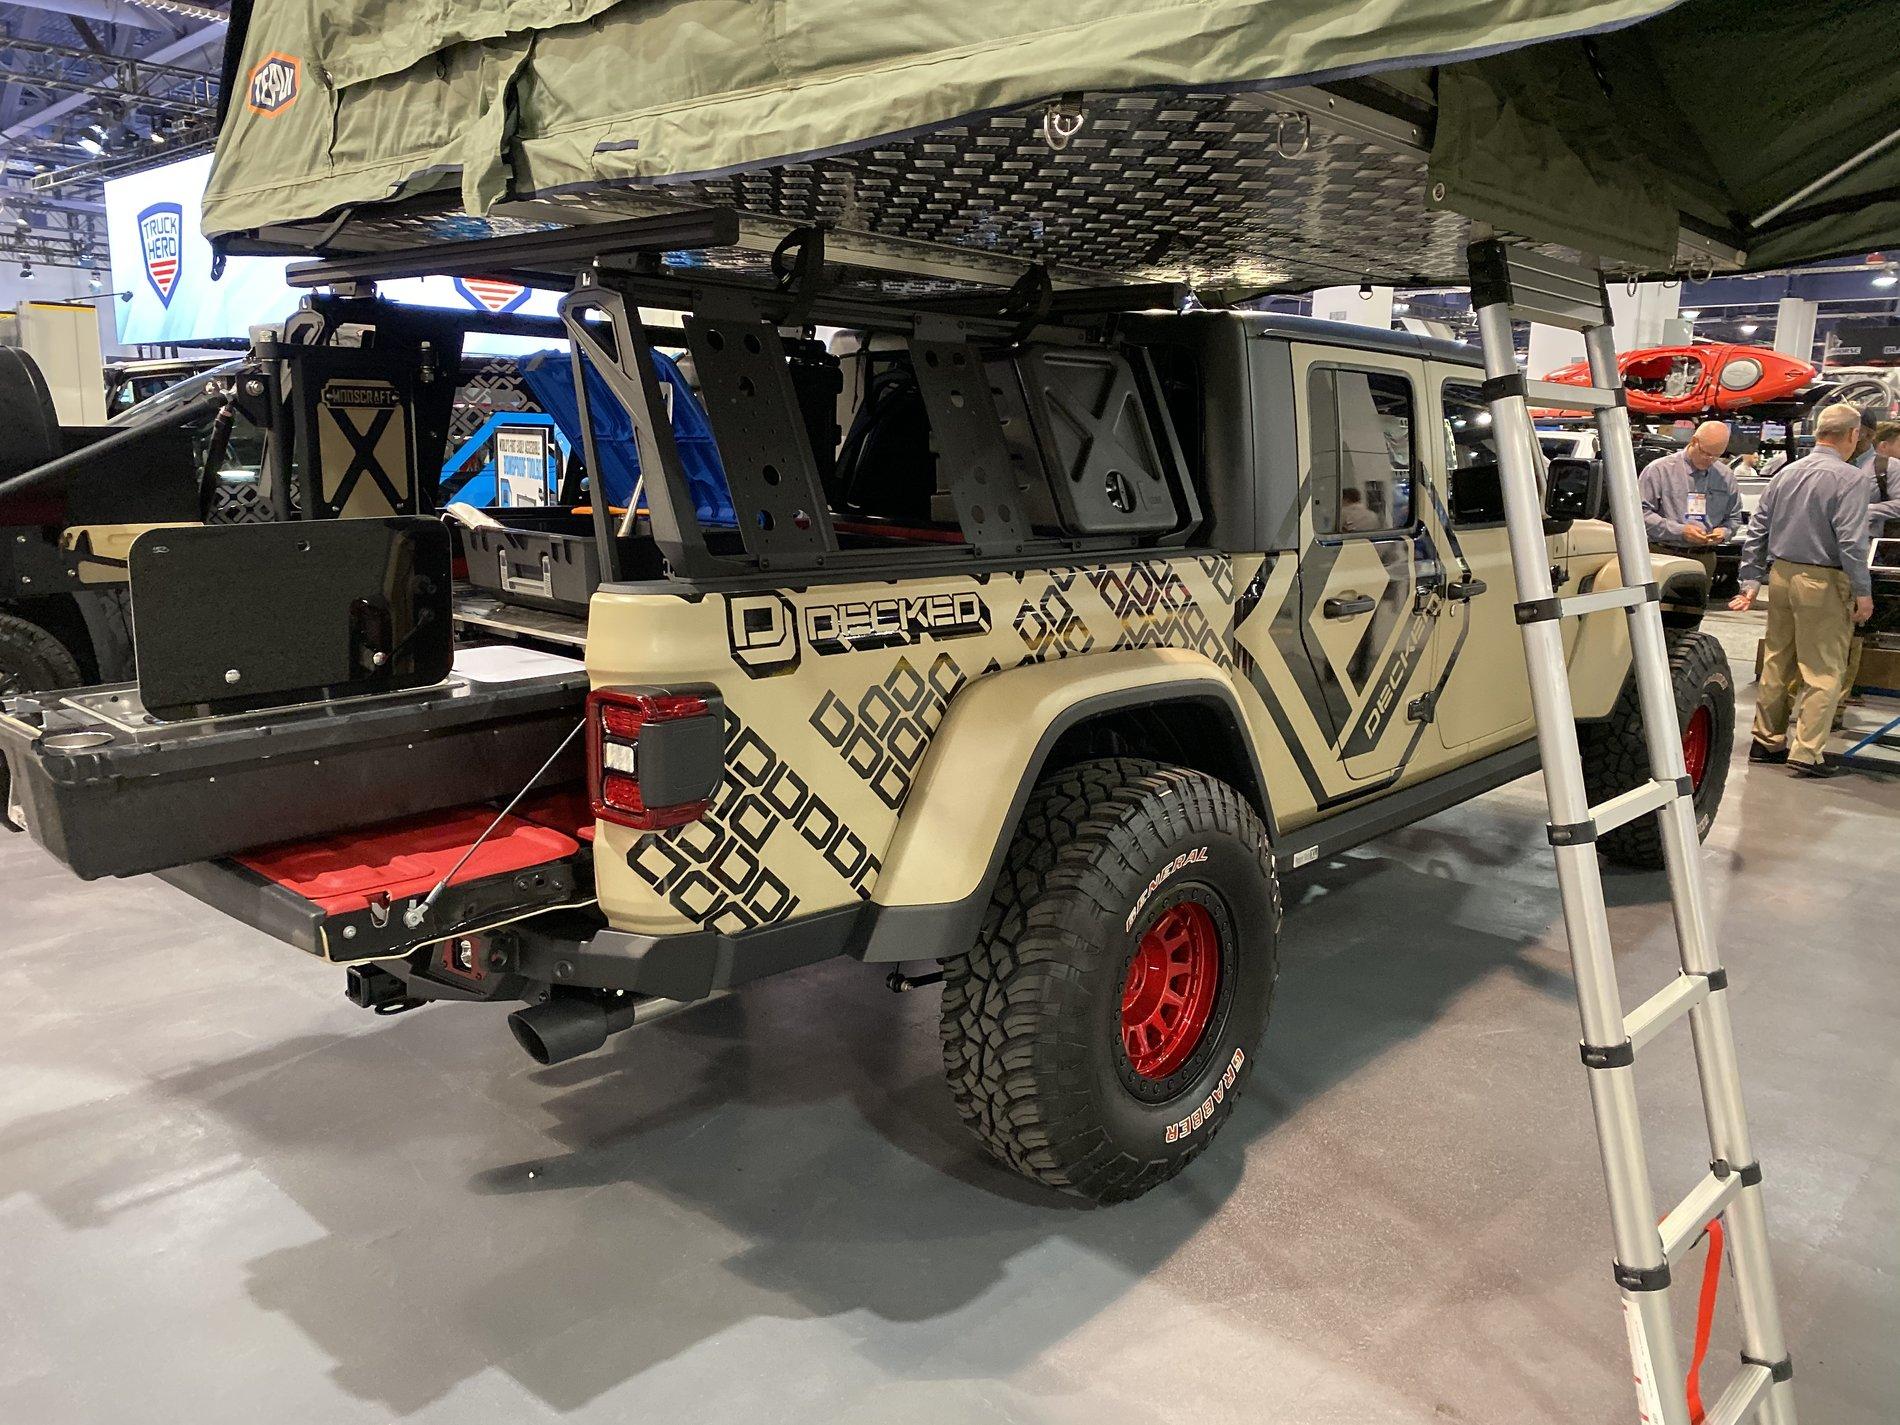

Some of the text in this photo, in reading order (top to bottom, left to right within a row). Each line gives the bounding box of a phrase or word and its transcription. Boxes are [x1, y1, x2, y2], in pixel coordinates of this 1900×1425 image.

[254, 63, 295, 108] TEPUI
[143, 216, 178, 240] TRUCK
[147, 236, 177, 261] HERO
[804, 591, 991, 656] DECKED
[1125, 846, 1209, 933] GENERAL
[1165, 1047, 1246, 1144] GRABBER
